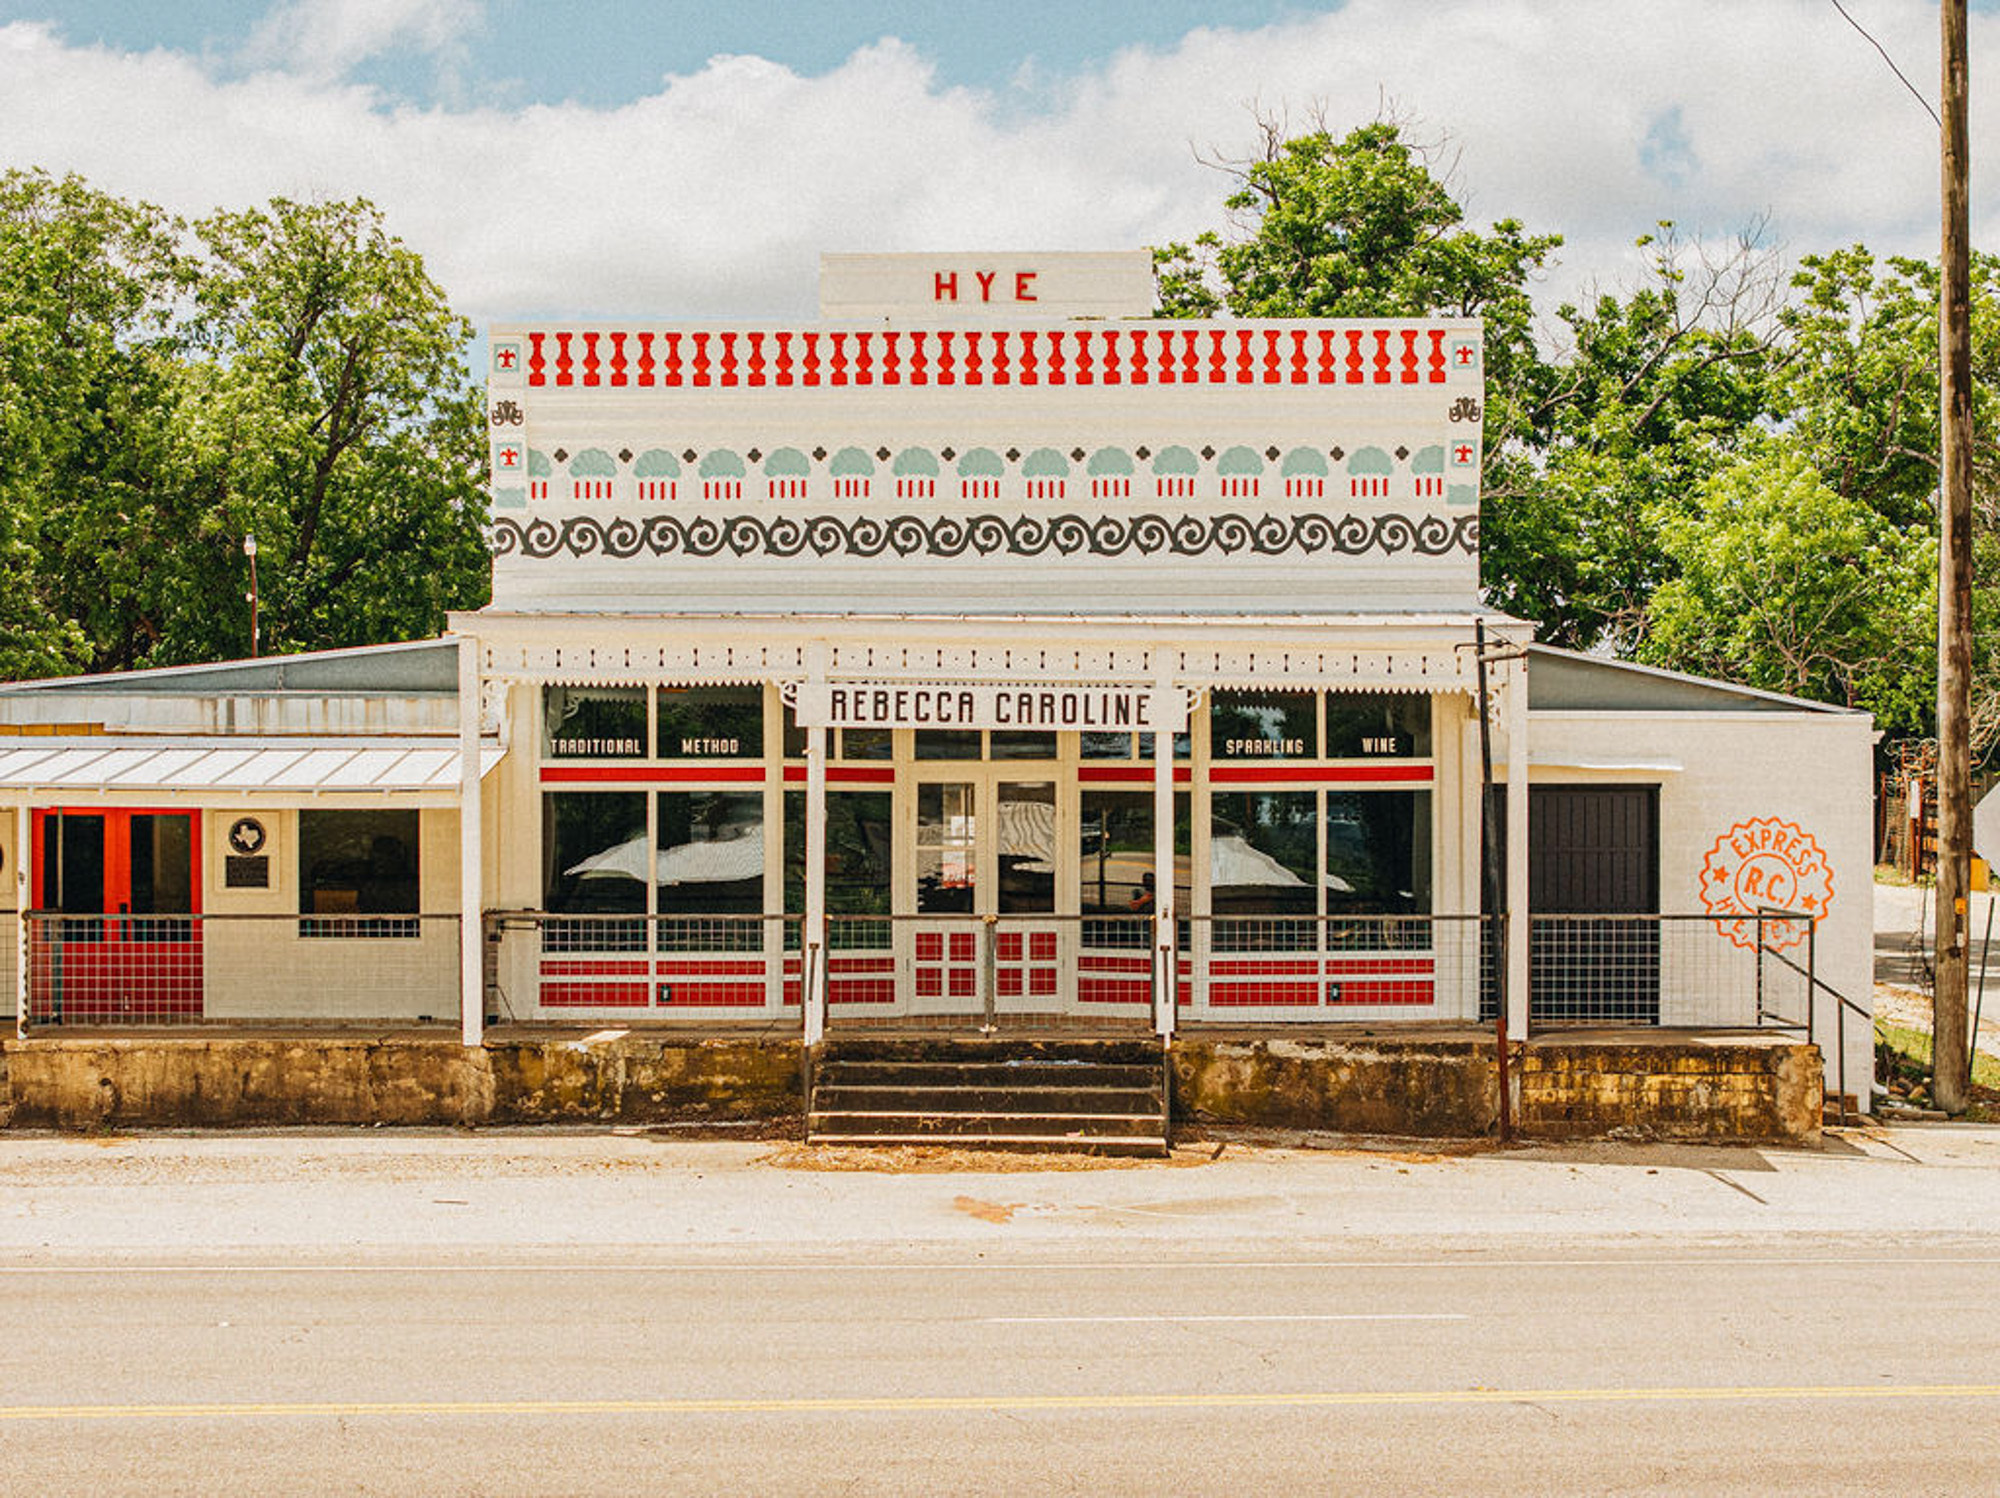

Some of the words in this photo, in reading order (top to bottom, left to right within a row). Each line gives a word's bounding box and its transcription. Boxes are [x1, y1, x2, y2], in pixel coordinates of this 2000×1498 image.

[934, 271, 1038, 302] HYE
[830, 689, 974, 723] REBECCA
[995, 692, 1151, 725] CAROLINE
[551, 738, 641, 754] TRADITIONAL
[682, 738, 739, 754] METHOD
[1226, 738, 1304, 754] SPARKLING
[1362, 737, 1396, 753] WINE
[1731, 828, 1817, 877] EXPRESS
